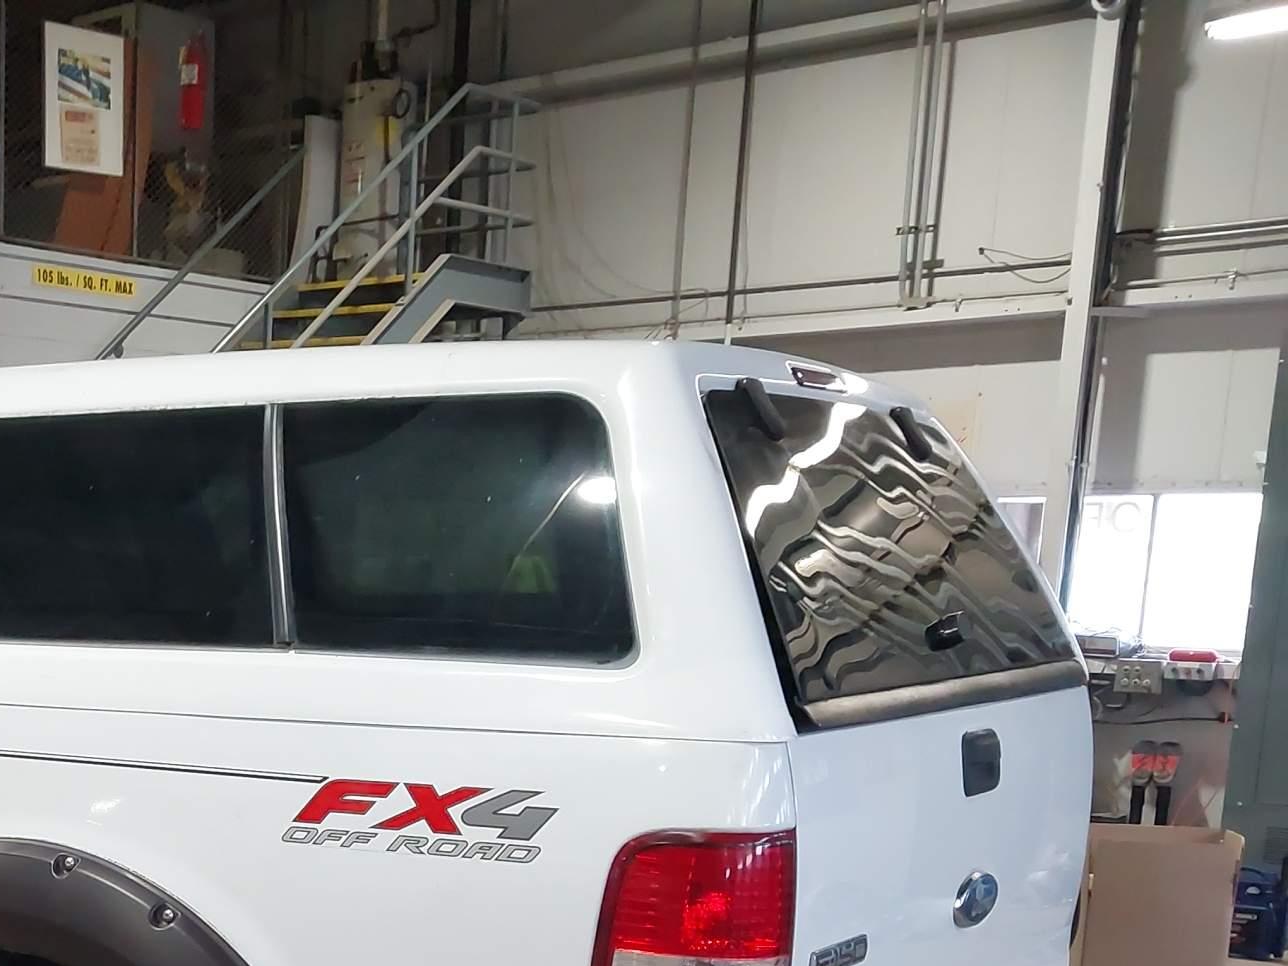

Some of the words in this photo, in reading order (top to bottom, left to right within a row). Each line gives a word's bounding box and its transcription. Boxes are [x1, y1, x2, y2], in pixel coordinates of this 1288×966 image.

[37, 268, 53, 283] 105
[57, 271, 73, 287] lbs.
[76, 274, 80, 287] /
[83, 275, 96, 290] SQ.
[100, 278, 112, 293] FT.
[115, 280, 133, 295] MAX
[292, 779, 560, 841] FX4
[281, 826, 378, 846] OFF
[385, 834, 541, 864] ROAD
